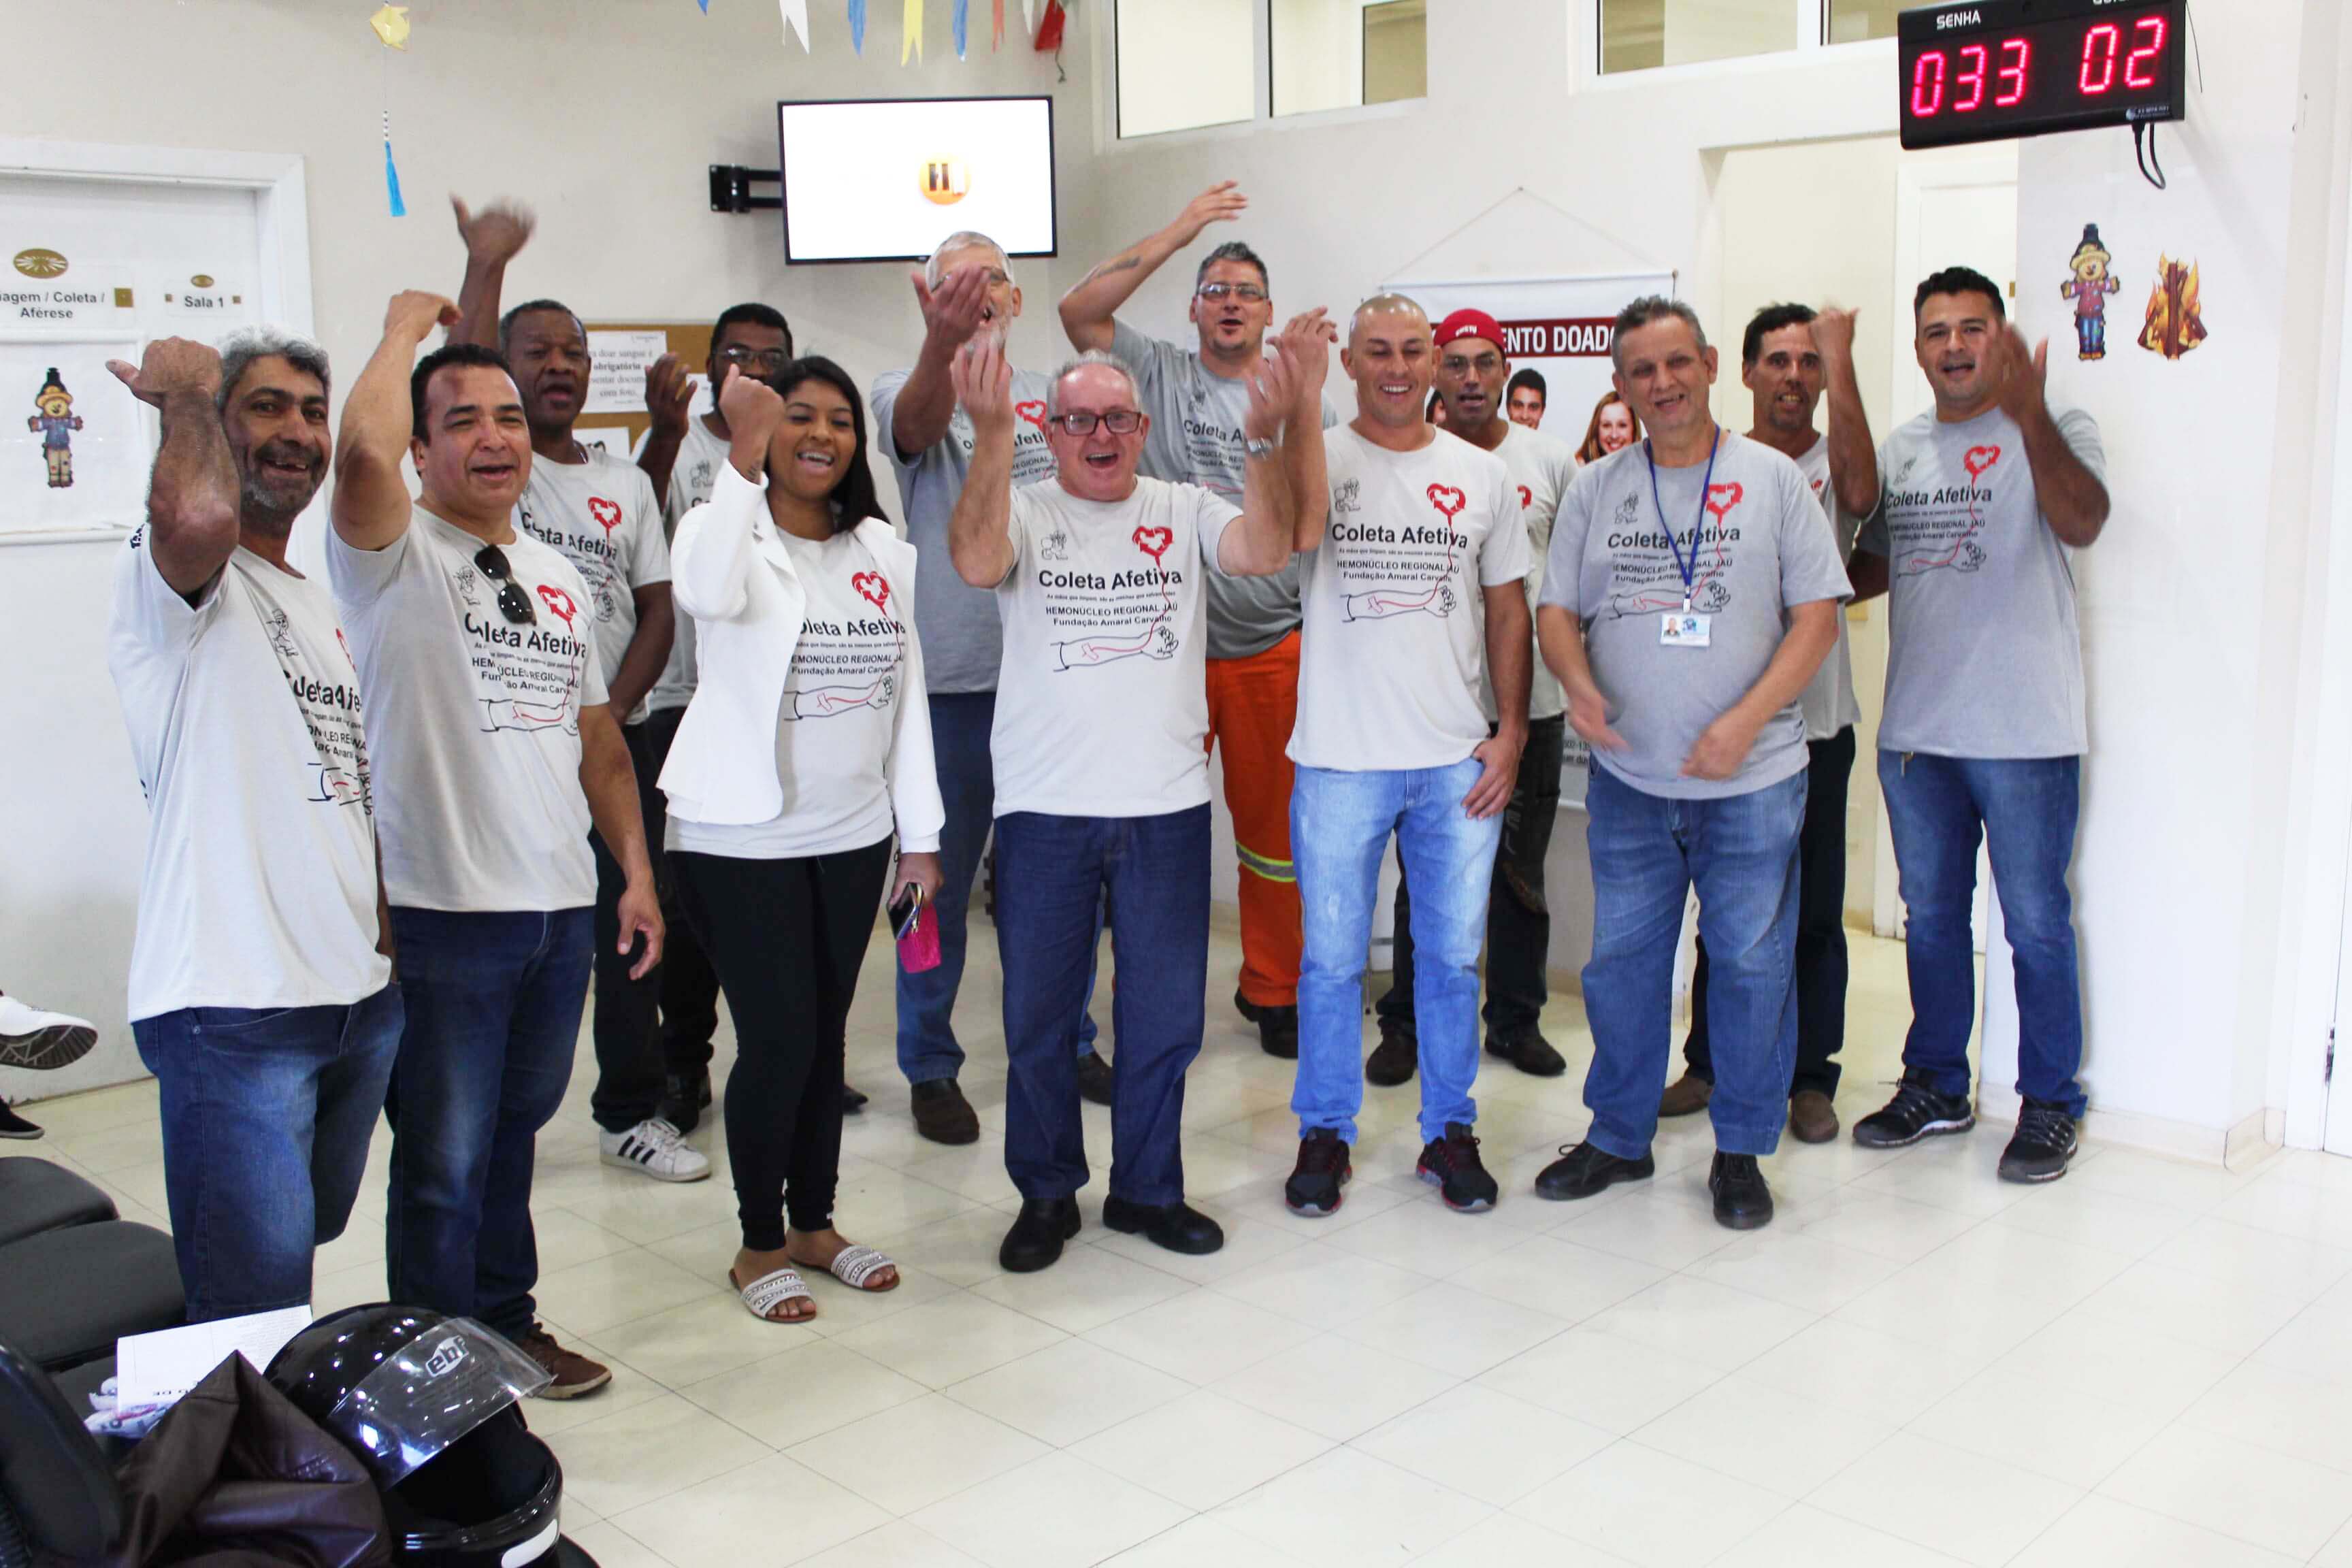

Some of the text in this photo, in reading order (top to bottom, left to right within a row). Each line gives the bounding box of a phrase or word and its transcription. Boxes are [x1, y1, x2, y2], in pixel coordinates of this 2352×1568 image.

[1936, 10, 1981, 31] SENHA
[1911, 16, 2167, 117] 033 02
[53, 291, 97, 304] Coleta
[184, 295, 224, 308] Sala 1
[1184, 420, 1226, 440] Coleta
[1886, 486, 1992, 508] Coleta Afetiva
[1332, 523, 1468, 549] Coleta Afetiva
[1608, 532, 1669, 549] Coleta
[1401, 561, 1444, 572] REGIONAL
[1039, 568, 1182, 590] Coleta Afetiva
[1343, 571, 1385, 582] Fundação
[1046, 605, 1111, 617] HEMONÚCLEO
[1113, 604, 1160, 615] REGIONAL
[1054, 617, 1098, 628] Fundação
[1100, 616, 1132, 625] Amaral
[851, 654, 892, 664] REGIONAL
[791, 666, 835, 676] Fundação
[837, 666, 865, 674] Amaral
